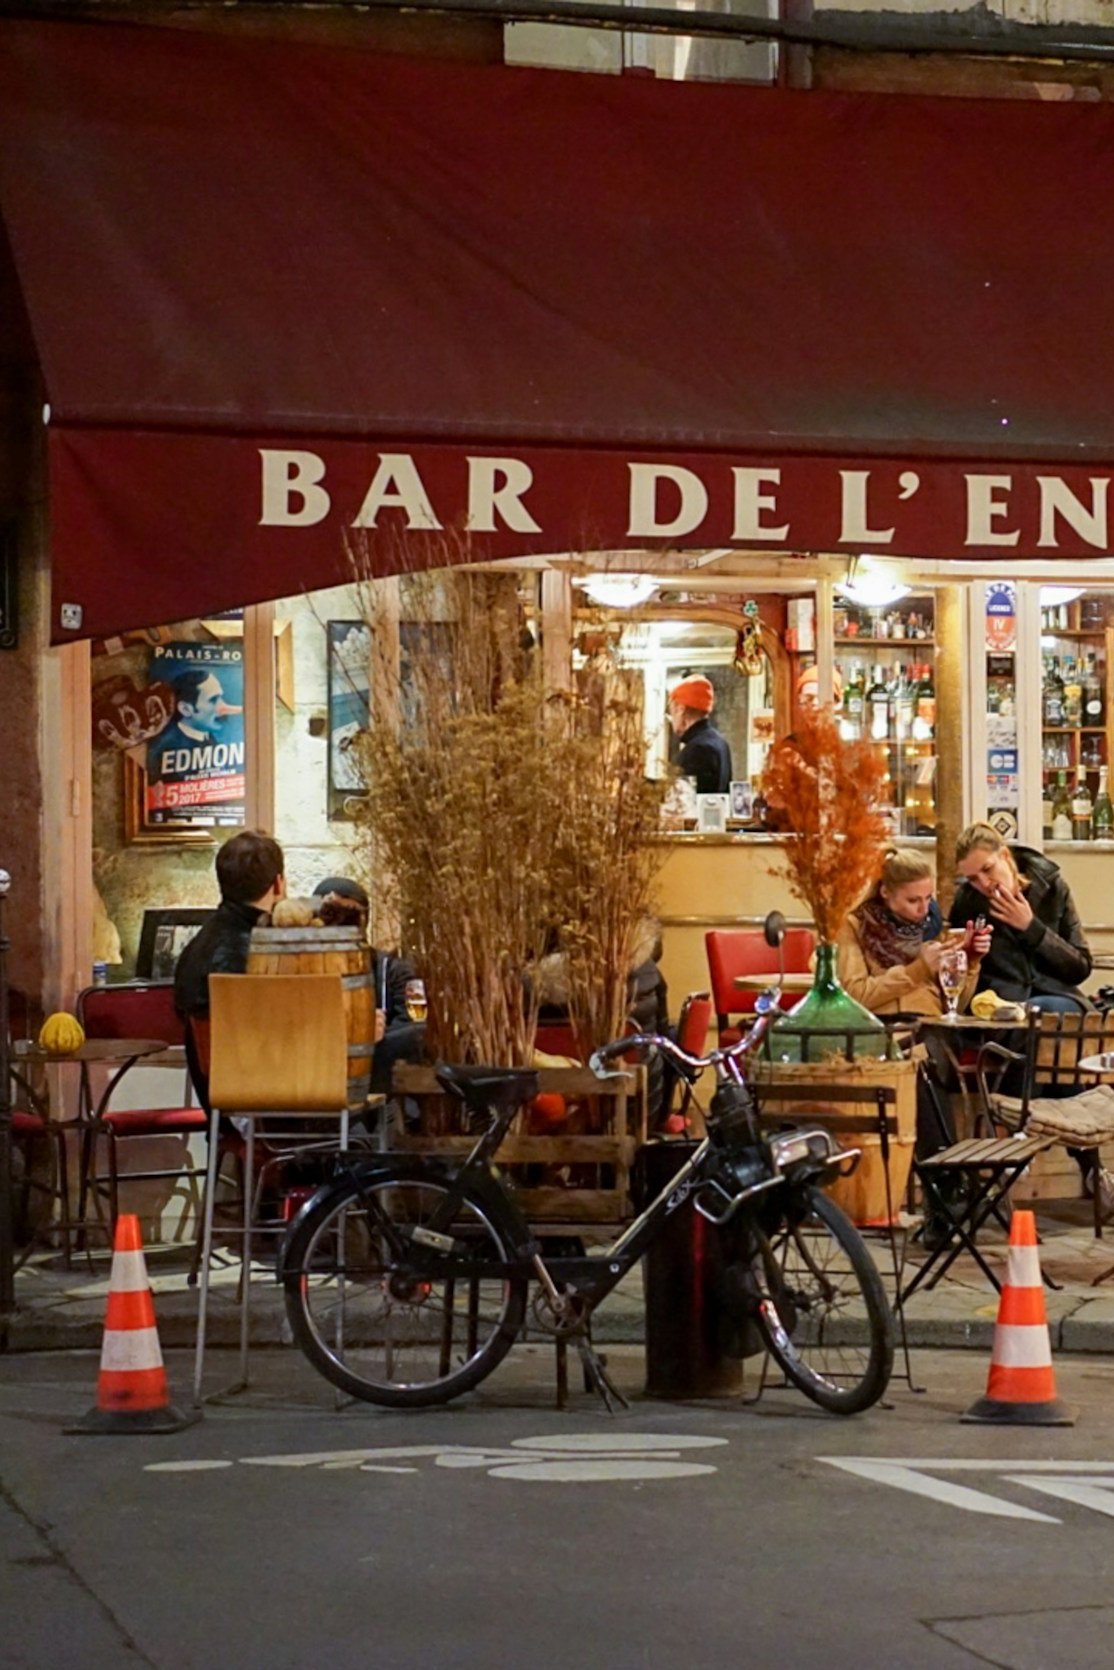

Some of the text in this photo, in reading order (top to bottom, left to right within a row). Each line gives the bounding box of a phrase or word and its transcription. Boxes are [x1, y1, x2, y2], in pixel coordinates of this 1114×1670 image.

[258, 448, 543, 533] BAR
[626, 462, 790, 541] DE
[161, 742, 245, 774] EDMON
[166, 784, 179, 806] 5
[178, 793, 201, 805] 2017
